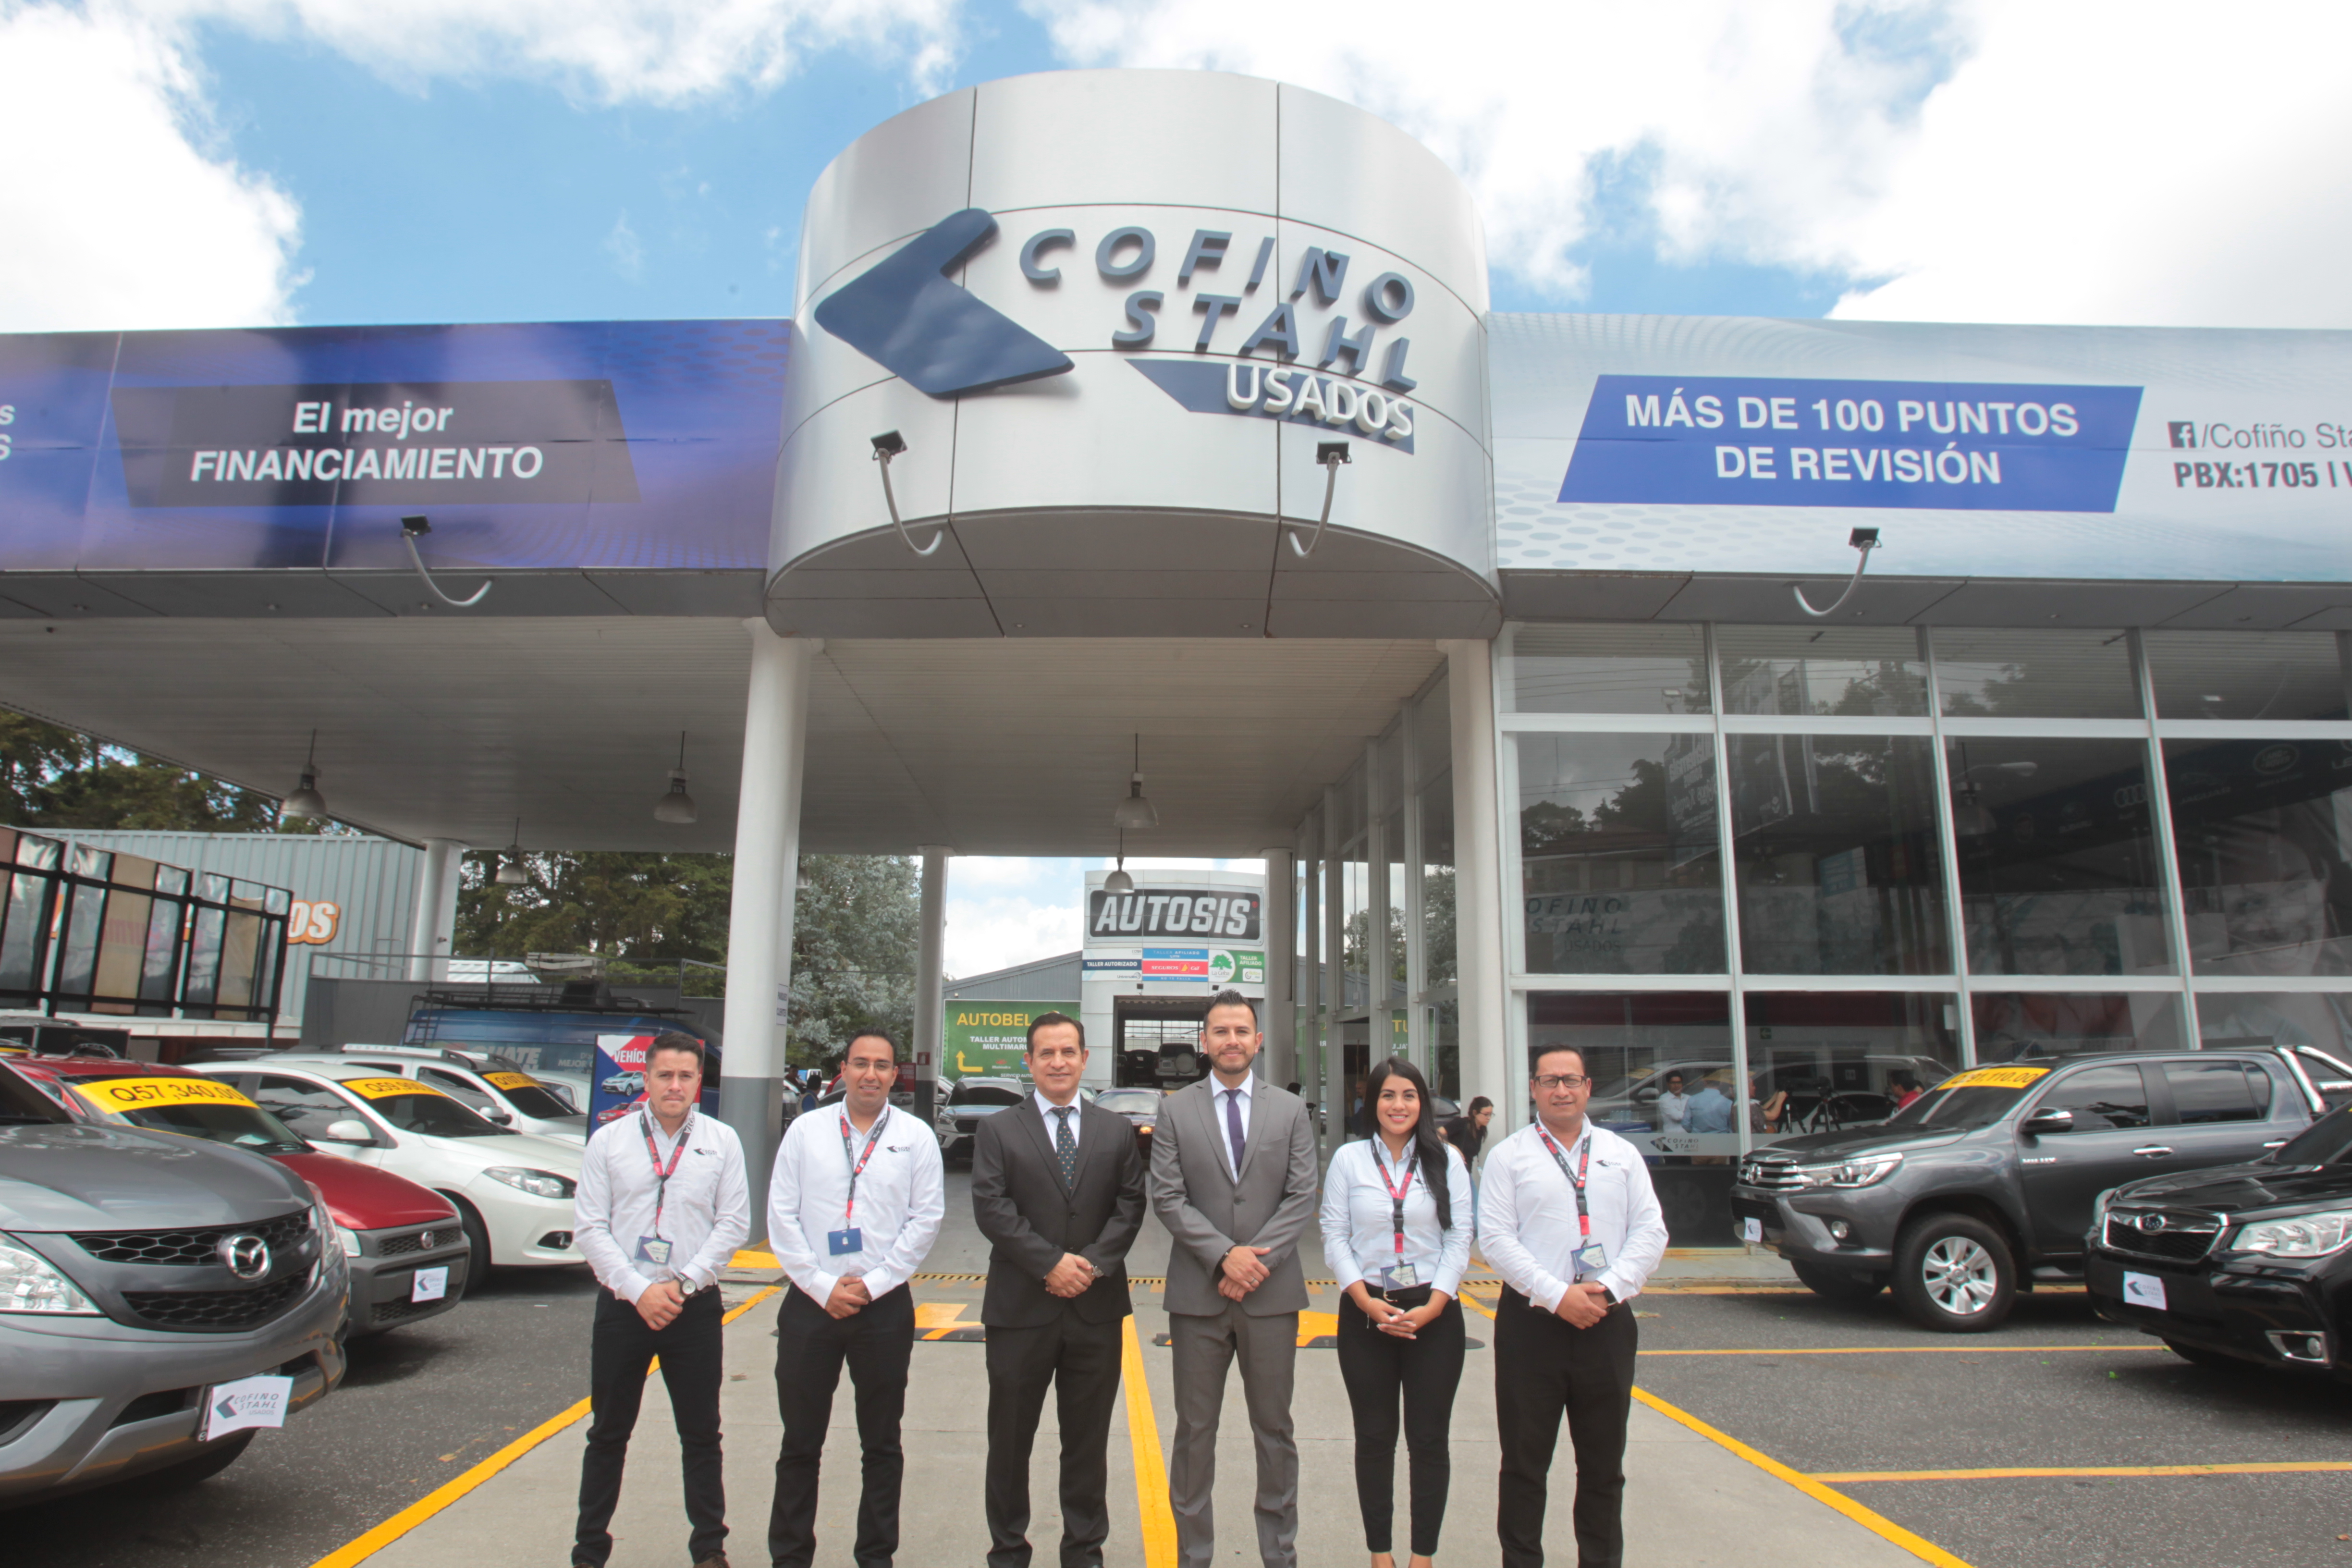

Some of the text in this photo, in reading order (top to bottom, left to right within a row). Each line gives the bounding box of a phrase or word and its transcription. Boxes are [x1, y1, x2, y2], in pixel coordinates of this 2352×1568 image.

[1112, 290, 1417, 393] STAHL
[1227, 362, 1413, 441] USADOS
[1626, 388, 2078, 436] MÁS DE 100 PUNTOS
[293, 401, 453, 440] El mejor
[192, 446, 543, 481] FINANCIAMIENTO
[1715, 442, 2001, 483] DE REVISIÓN
[2173, 461, 2319, 488] PBX:1705
[1094, 895, 1250, 935] AUTOSIS
[1531, 918, 1621, 934] STAHL
[1565, 940, 1621, 952] USADOS
[956, 1013, 1032, 1026] AUTOBEL
[614, 1049, 646, 1063] VEHÍCU
[240, 1401, 277, 1410] STAHL
